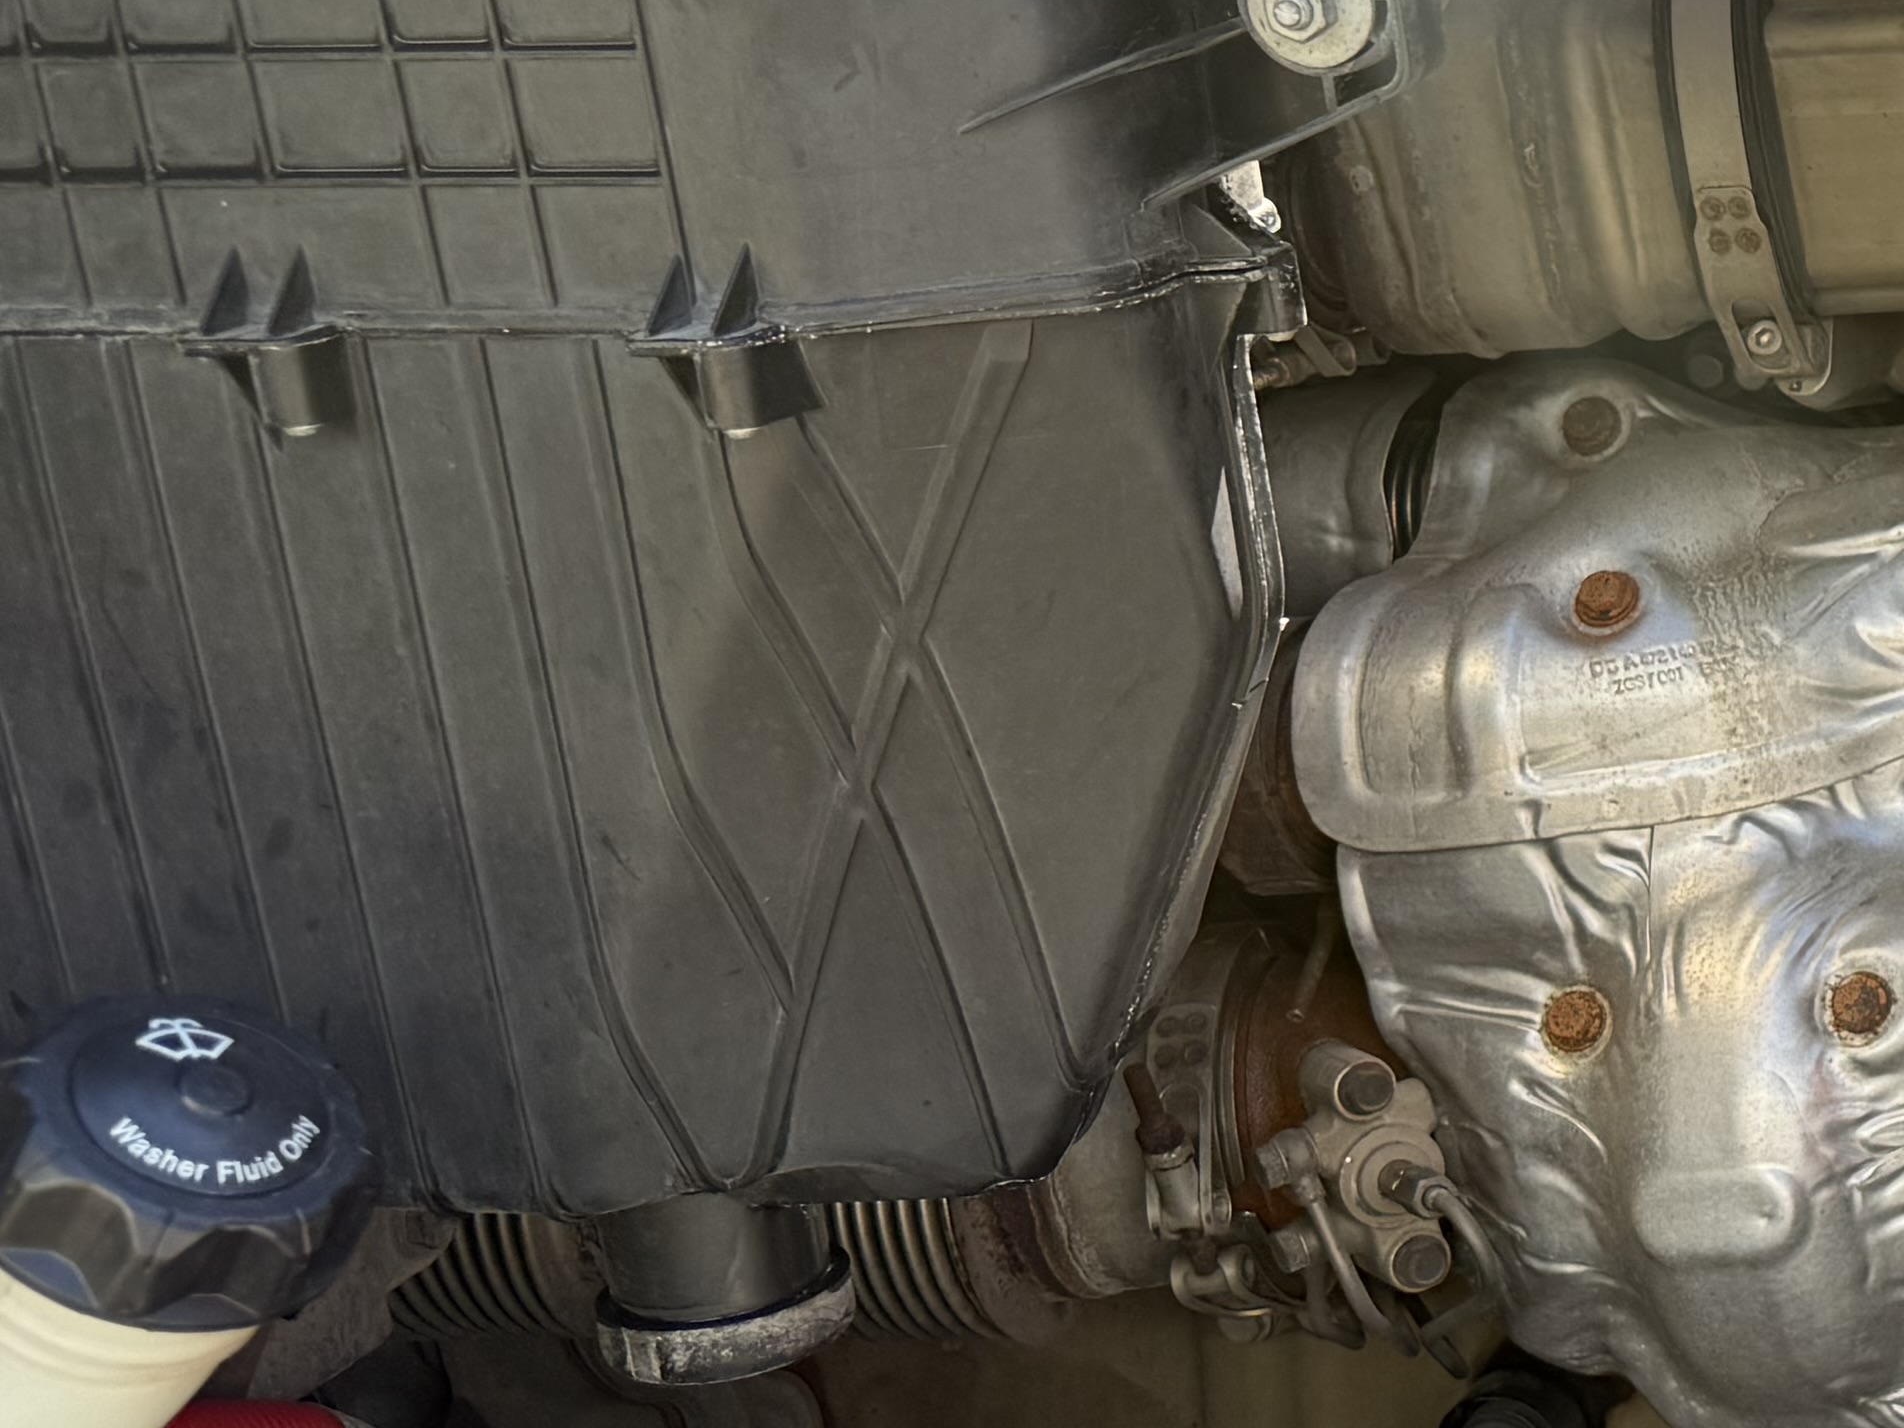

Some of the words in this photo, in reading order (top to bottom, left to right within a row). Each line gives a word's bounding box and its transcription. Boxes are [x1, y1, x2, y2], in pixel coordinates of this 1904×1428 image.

[108, 1117, 209, 1183] Washer
[216, 1150, 283, 1184] Fluid
[279, 1114, 321, 1163] Only
